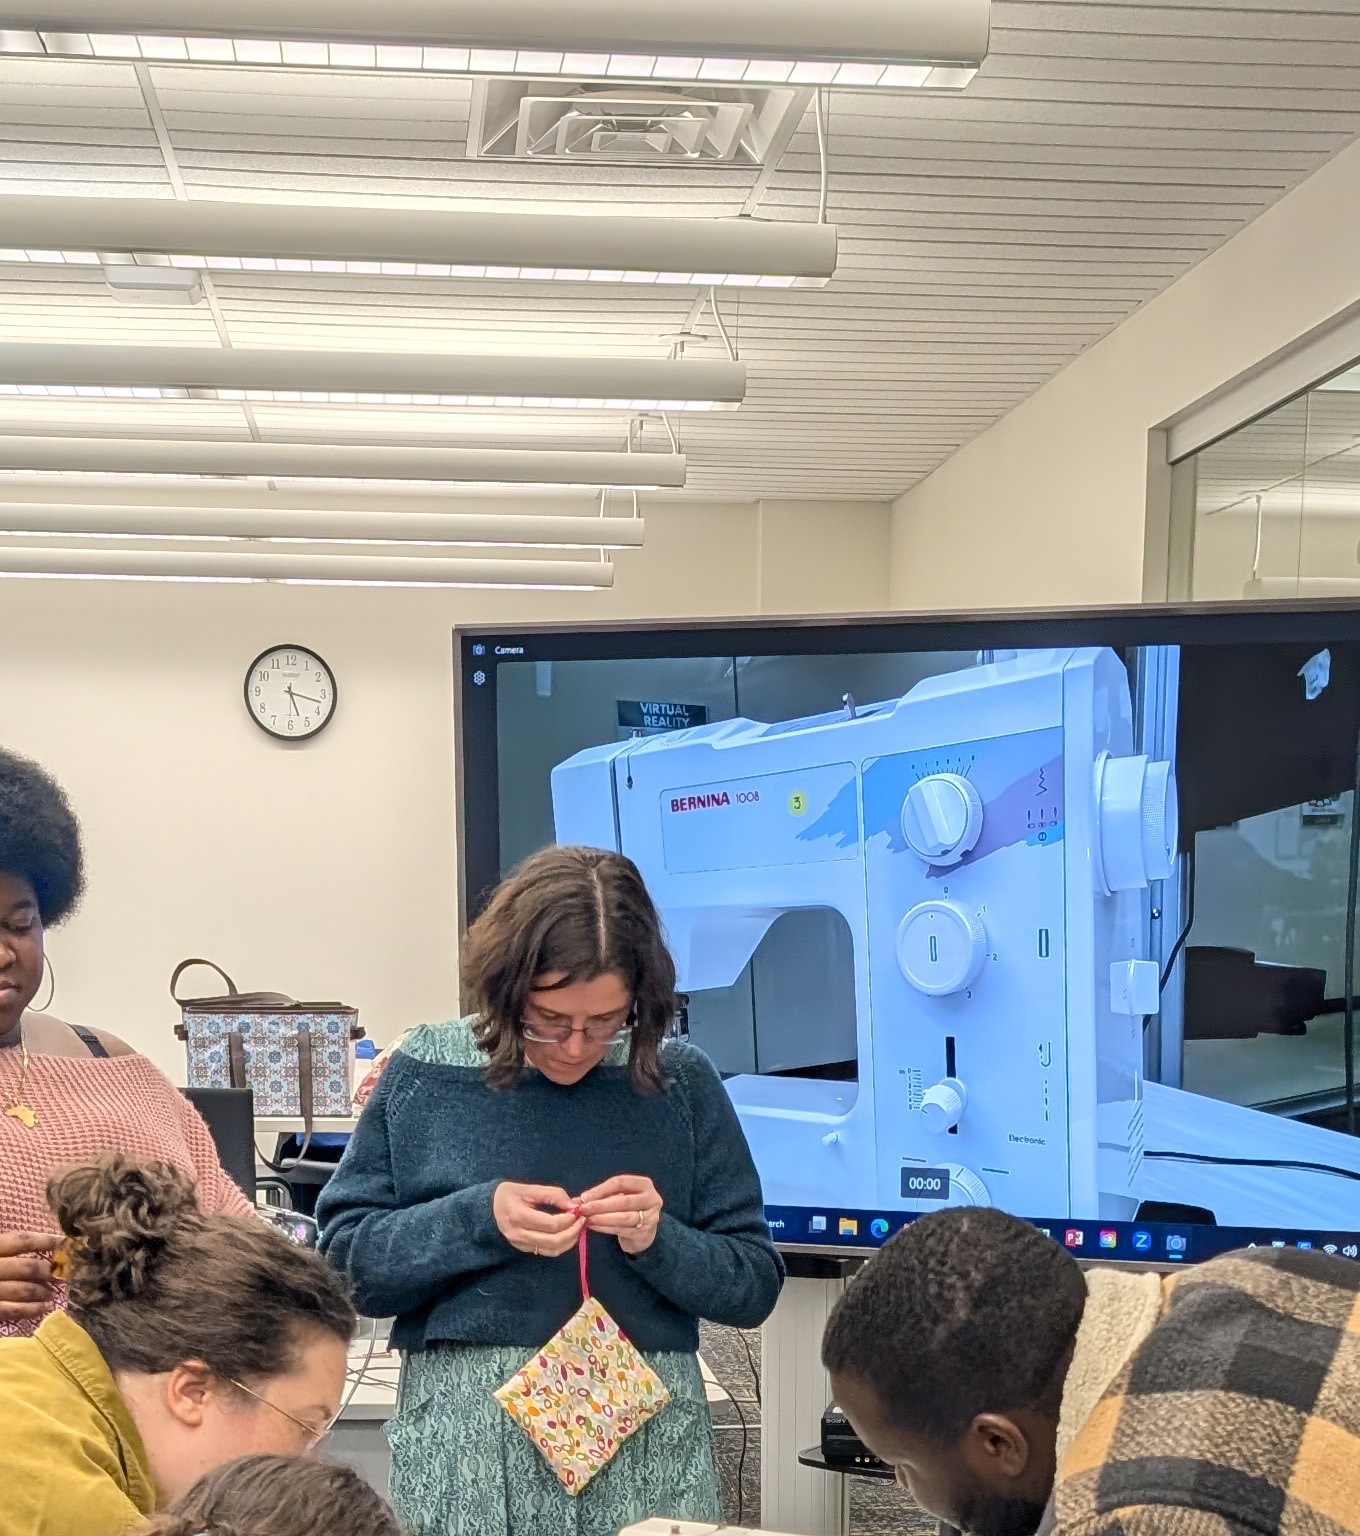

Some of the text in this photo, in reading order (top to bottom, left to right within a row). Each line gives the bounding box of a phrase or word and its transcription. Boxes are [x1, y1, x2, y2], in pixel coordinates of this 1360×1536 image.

[494, 645, 524, 655] Camera
[271, 658, 281, 670] 11
[285, 655, 297, 666] 12
[304, 660, 309, 671] 1
[258, 670, 270, 682] 10
[314, 671, 322, 682] 2
[254, 685, 261, 697] 9
[320, 688, 326, 699] 3
[259, 702, 266, 713] 8
[314, 705, 321, 716] 4
[640, 702, 689, 716] VIRTUAL
[270, 714, 277, 725] 7
[287, 719, 294, 731] 6
[304, 716, 310, 728] 5
[643, 715, 690, 728] REALITY
[670, 790, 802, 813] BERNINA 1008 3
[992, 953, 998, 961] 2
[1008, 1133, 1046, 1146] Electronic
[908, 1176, 941, 1191] 00:00
[767, 1219, 785, 1229] arch
